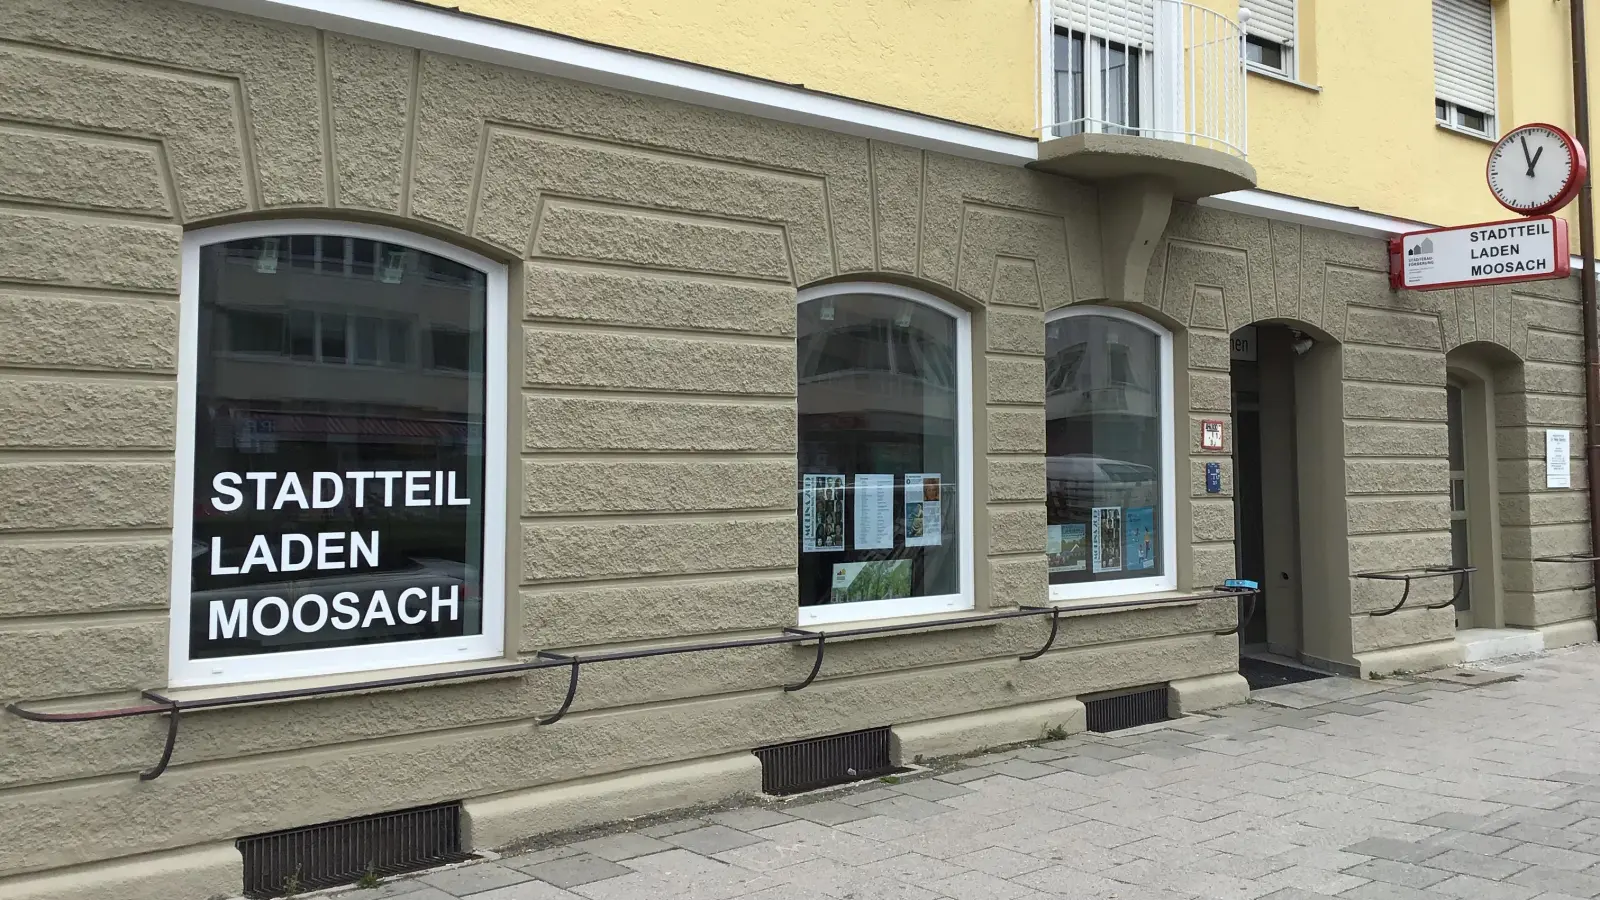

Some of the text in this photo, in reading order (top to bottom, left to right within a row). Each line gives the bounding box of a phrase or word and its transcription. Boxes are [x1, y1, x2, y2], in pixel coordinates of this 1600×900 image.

[1470, 224, 1549, 242] STADTTEIL
[1471, 244, 1519, 259] LADEN
[1471, 259, 1546, 276] MOOSACH
[210, 471, 471, 511] STADTTEIL
[210, 530, 379, 575] LADEN
[208, 585, 459, 640] MOOSACH
